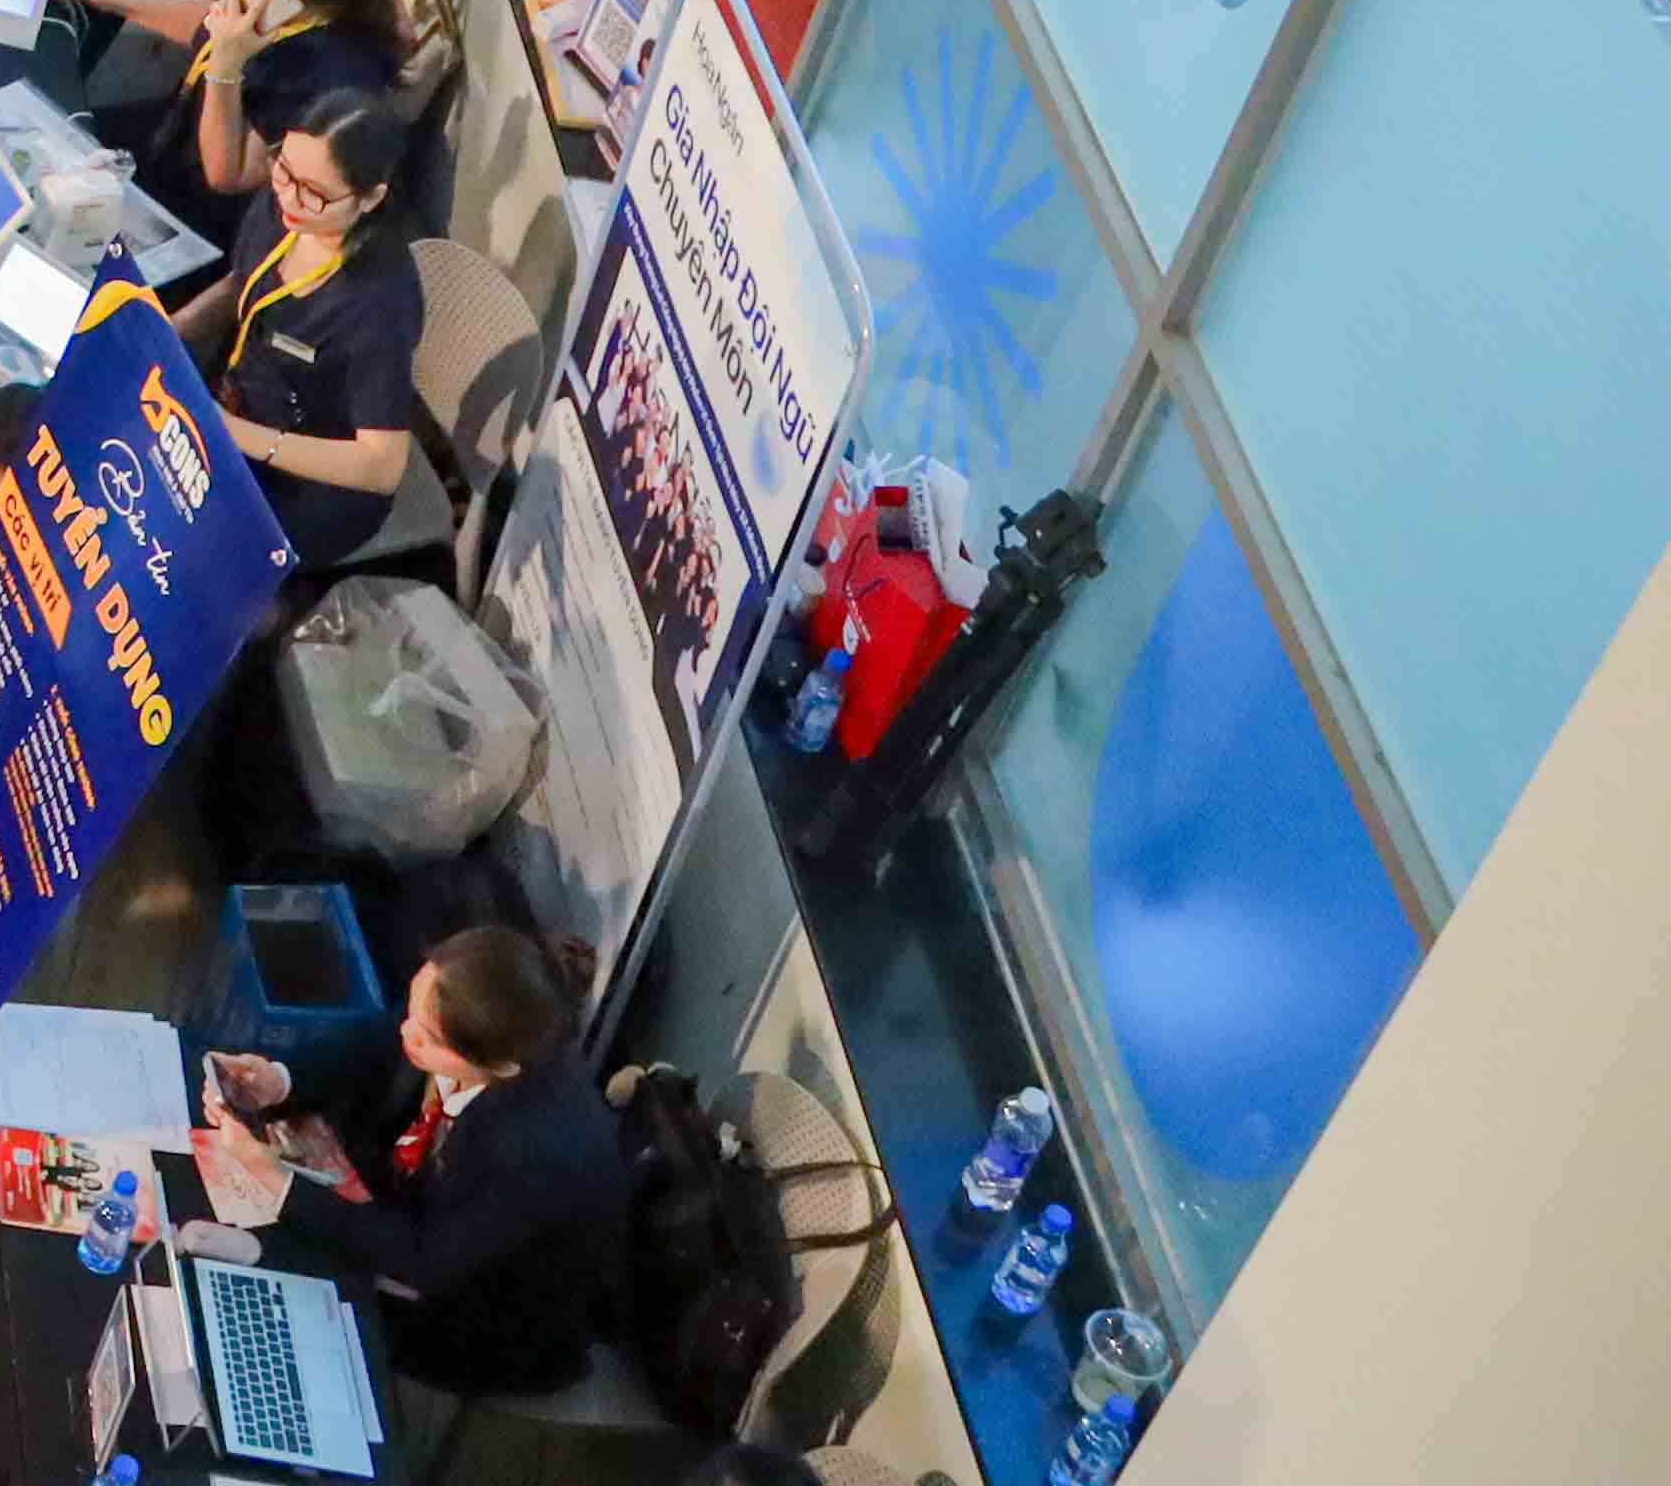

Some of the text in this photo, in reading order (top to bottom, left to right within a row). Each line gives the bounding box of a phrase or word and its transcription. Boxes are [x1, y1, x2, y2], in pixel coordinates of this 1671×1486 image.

[648, 136, 755, 416] Chuyên Môn
[664, 82, 818, 465] Gia Nhập Đội Ngũ
[2, 492, 64, 612] Các vị trí
[26, 422, 113, 585] TUYỂN
[94, 587, 175, 748] DỤNG
